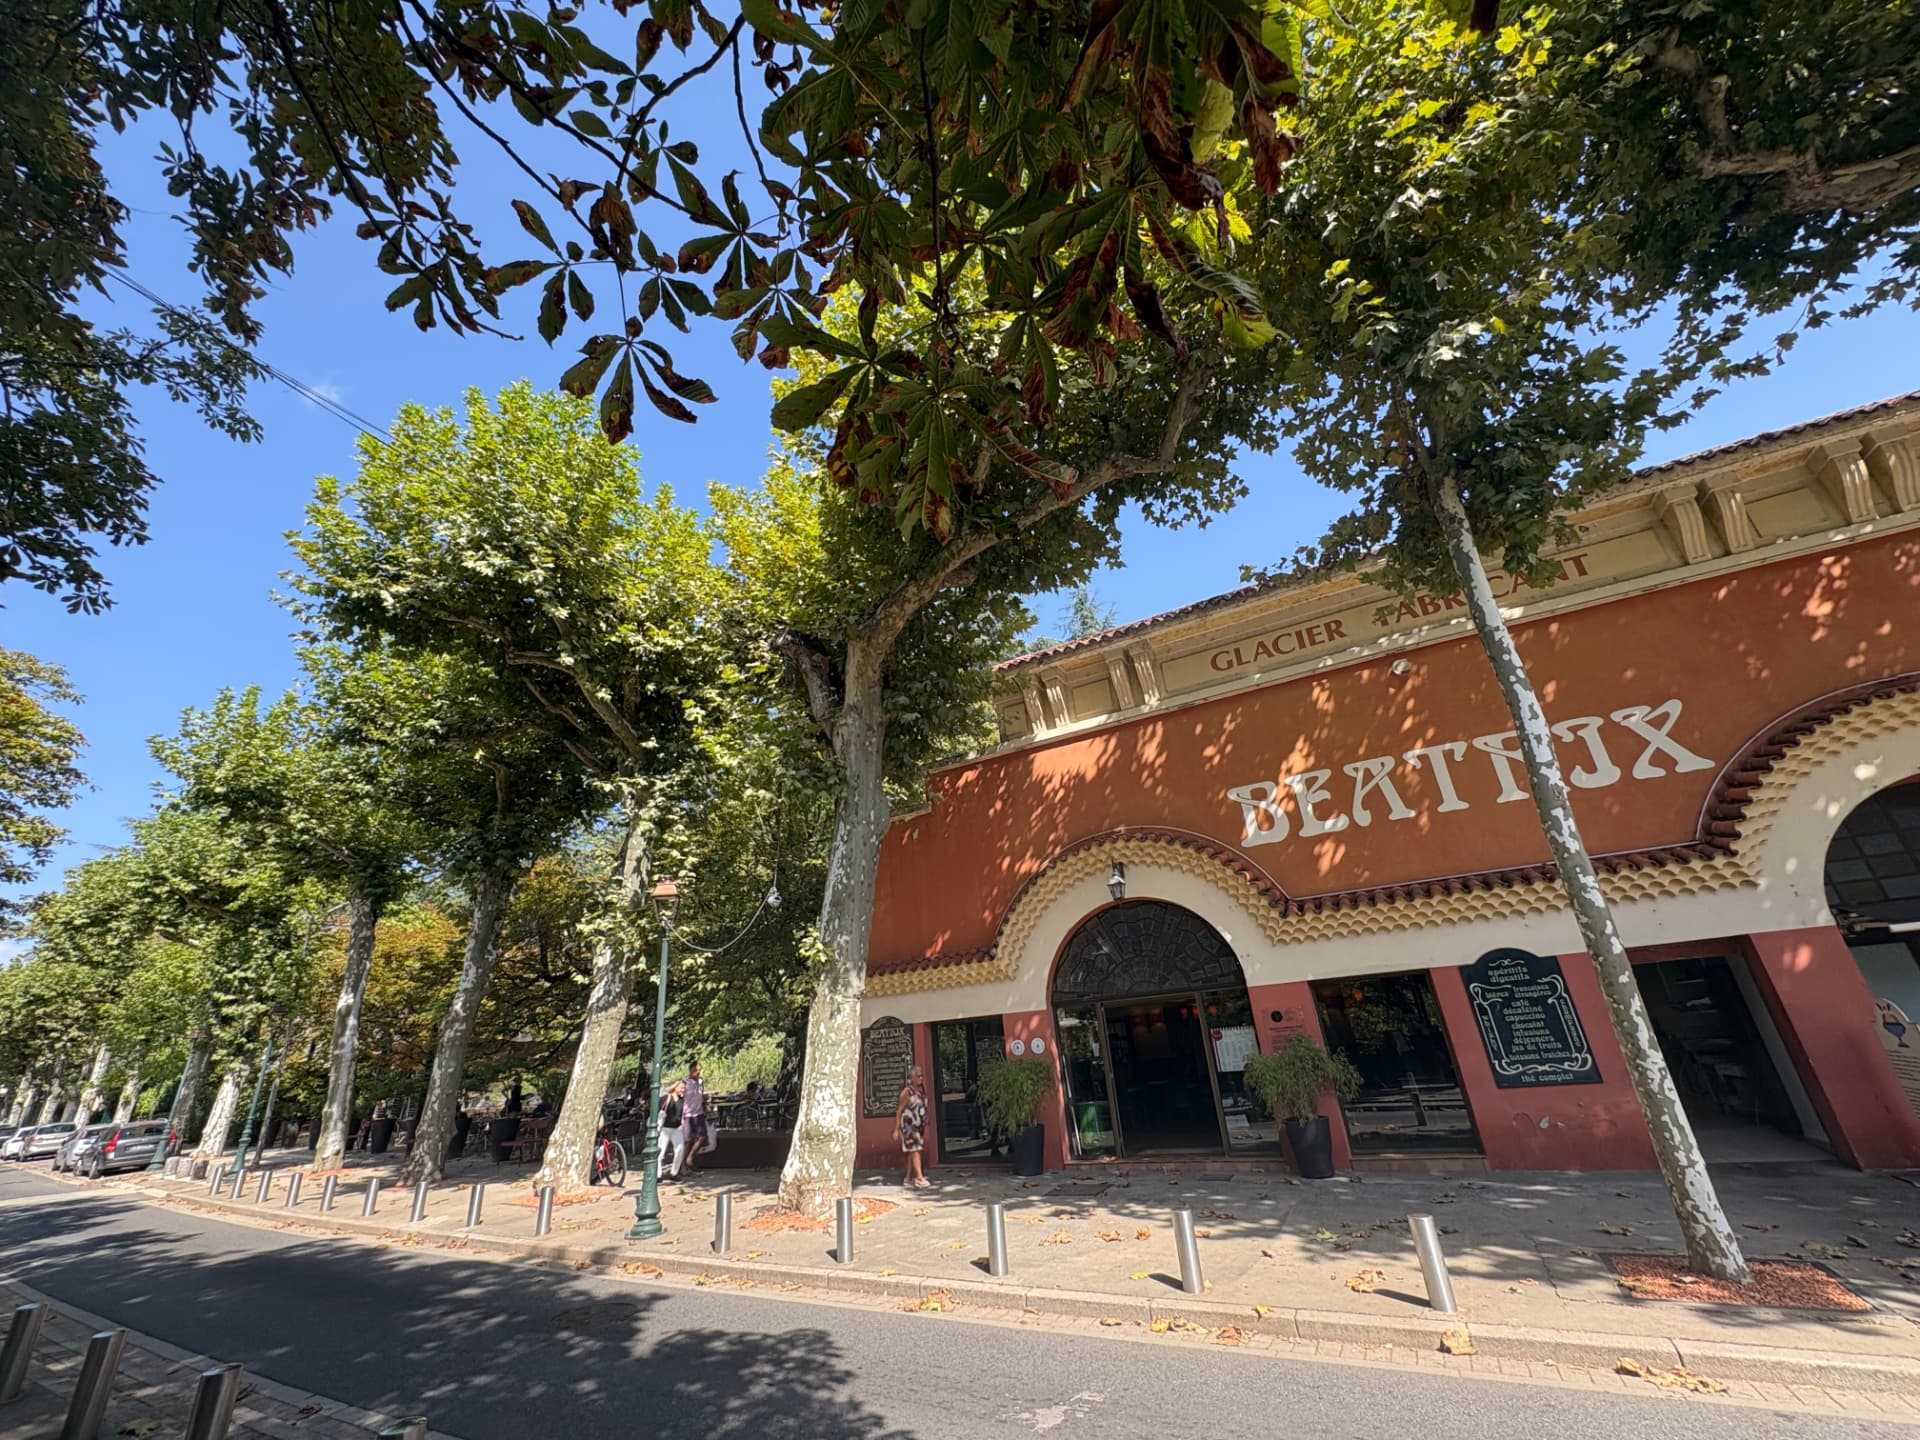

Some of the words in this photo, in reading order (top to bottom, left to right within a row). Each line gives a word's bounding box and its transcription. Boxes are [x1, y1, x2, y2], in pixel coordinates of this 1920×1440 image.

[1210, 619, 1346, 673] GLACIER
[1227, 698, 1716, 849] BEATRIX
[1512, 1020, 1544, 1030] chocolat
[1513, 1028, 1549, 1037] infusions
[1512, 1045, 1524, 1053] jus
[1527, 1043, 1536, 1052] de
[1540, 1042, 1561, 1051] fruits
[1540, 1073, 1573, 1083] complet
